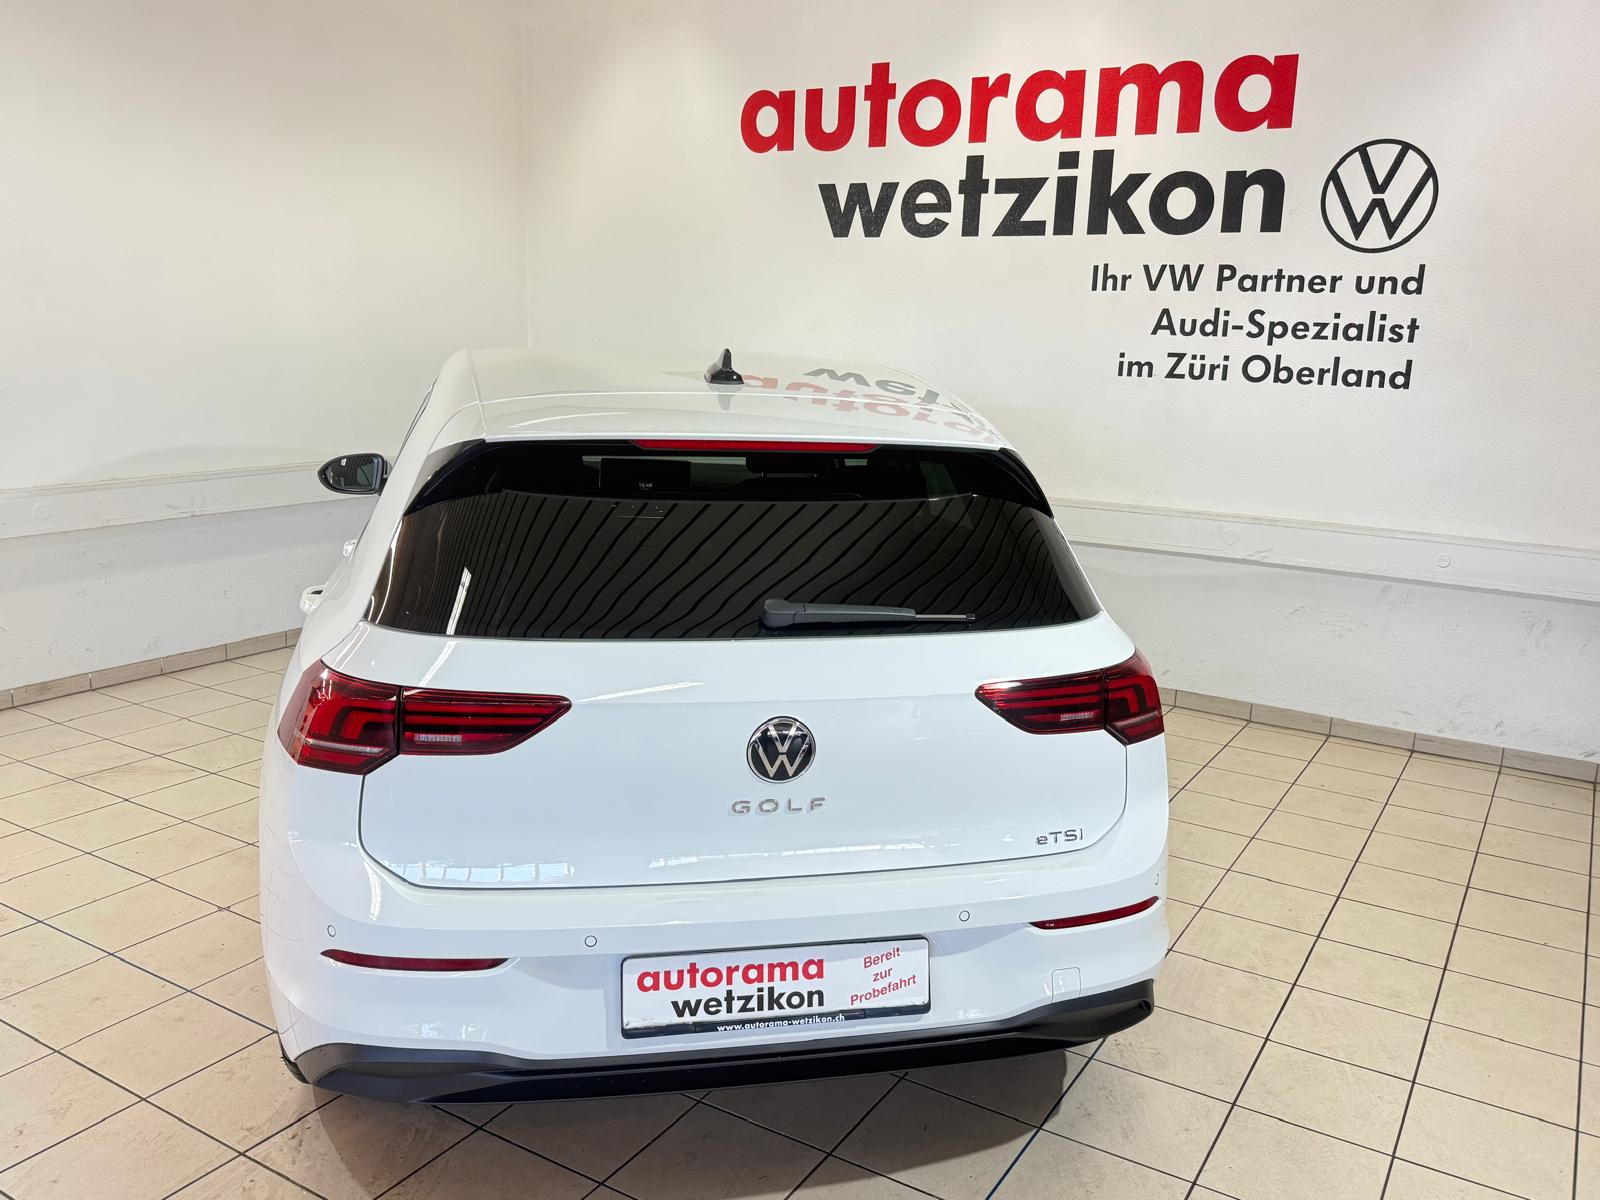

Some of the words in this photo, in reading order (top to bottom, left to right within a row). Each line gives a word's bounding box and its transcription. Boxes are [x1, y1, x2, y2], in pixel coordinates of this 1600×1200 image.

[740, 53, 1299, 154] autorama
[818, 149, 1286, 239] wetzikon
[1091, 264, 1132, 292] Ihr
[1142, 264, 1205, 292] VW
[1216, 264, 1343, 294] Partner
[1355, 264, 1426, 296] und
[1150, 307, 1420, 346] Audi-Spezialist
[1117, 353, 1154, 378] im
[1165, 352, 1230, 381] Züri
[1241, 354, 1413, 390] Oberland
[731, 796, 826, 815] GOLF
[1036, 828, 1084, 846] eTSI
[863, 946, 901, 969] Bereit
[637, 959, 825, 993] autorama
[850, 973, 917, 1006] Probefahrt
[872, 965, 893, 983] zur
[671, 986, 825, 1018] wetzikon
[716, 1013, 846, 1032] www.autorama-wetzikon.ch
